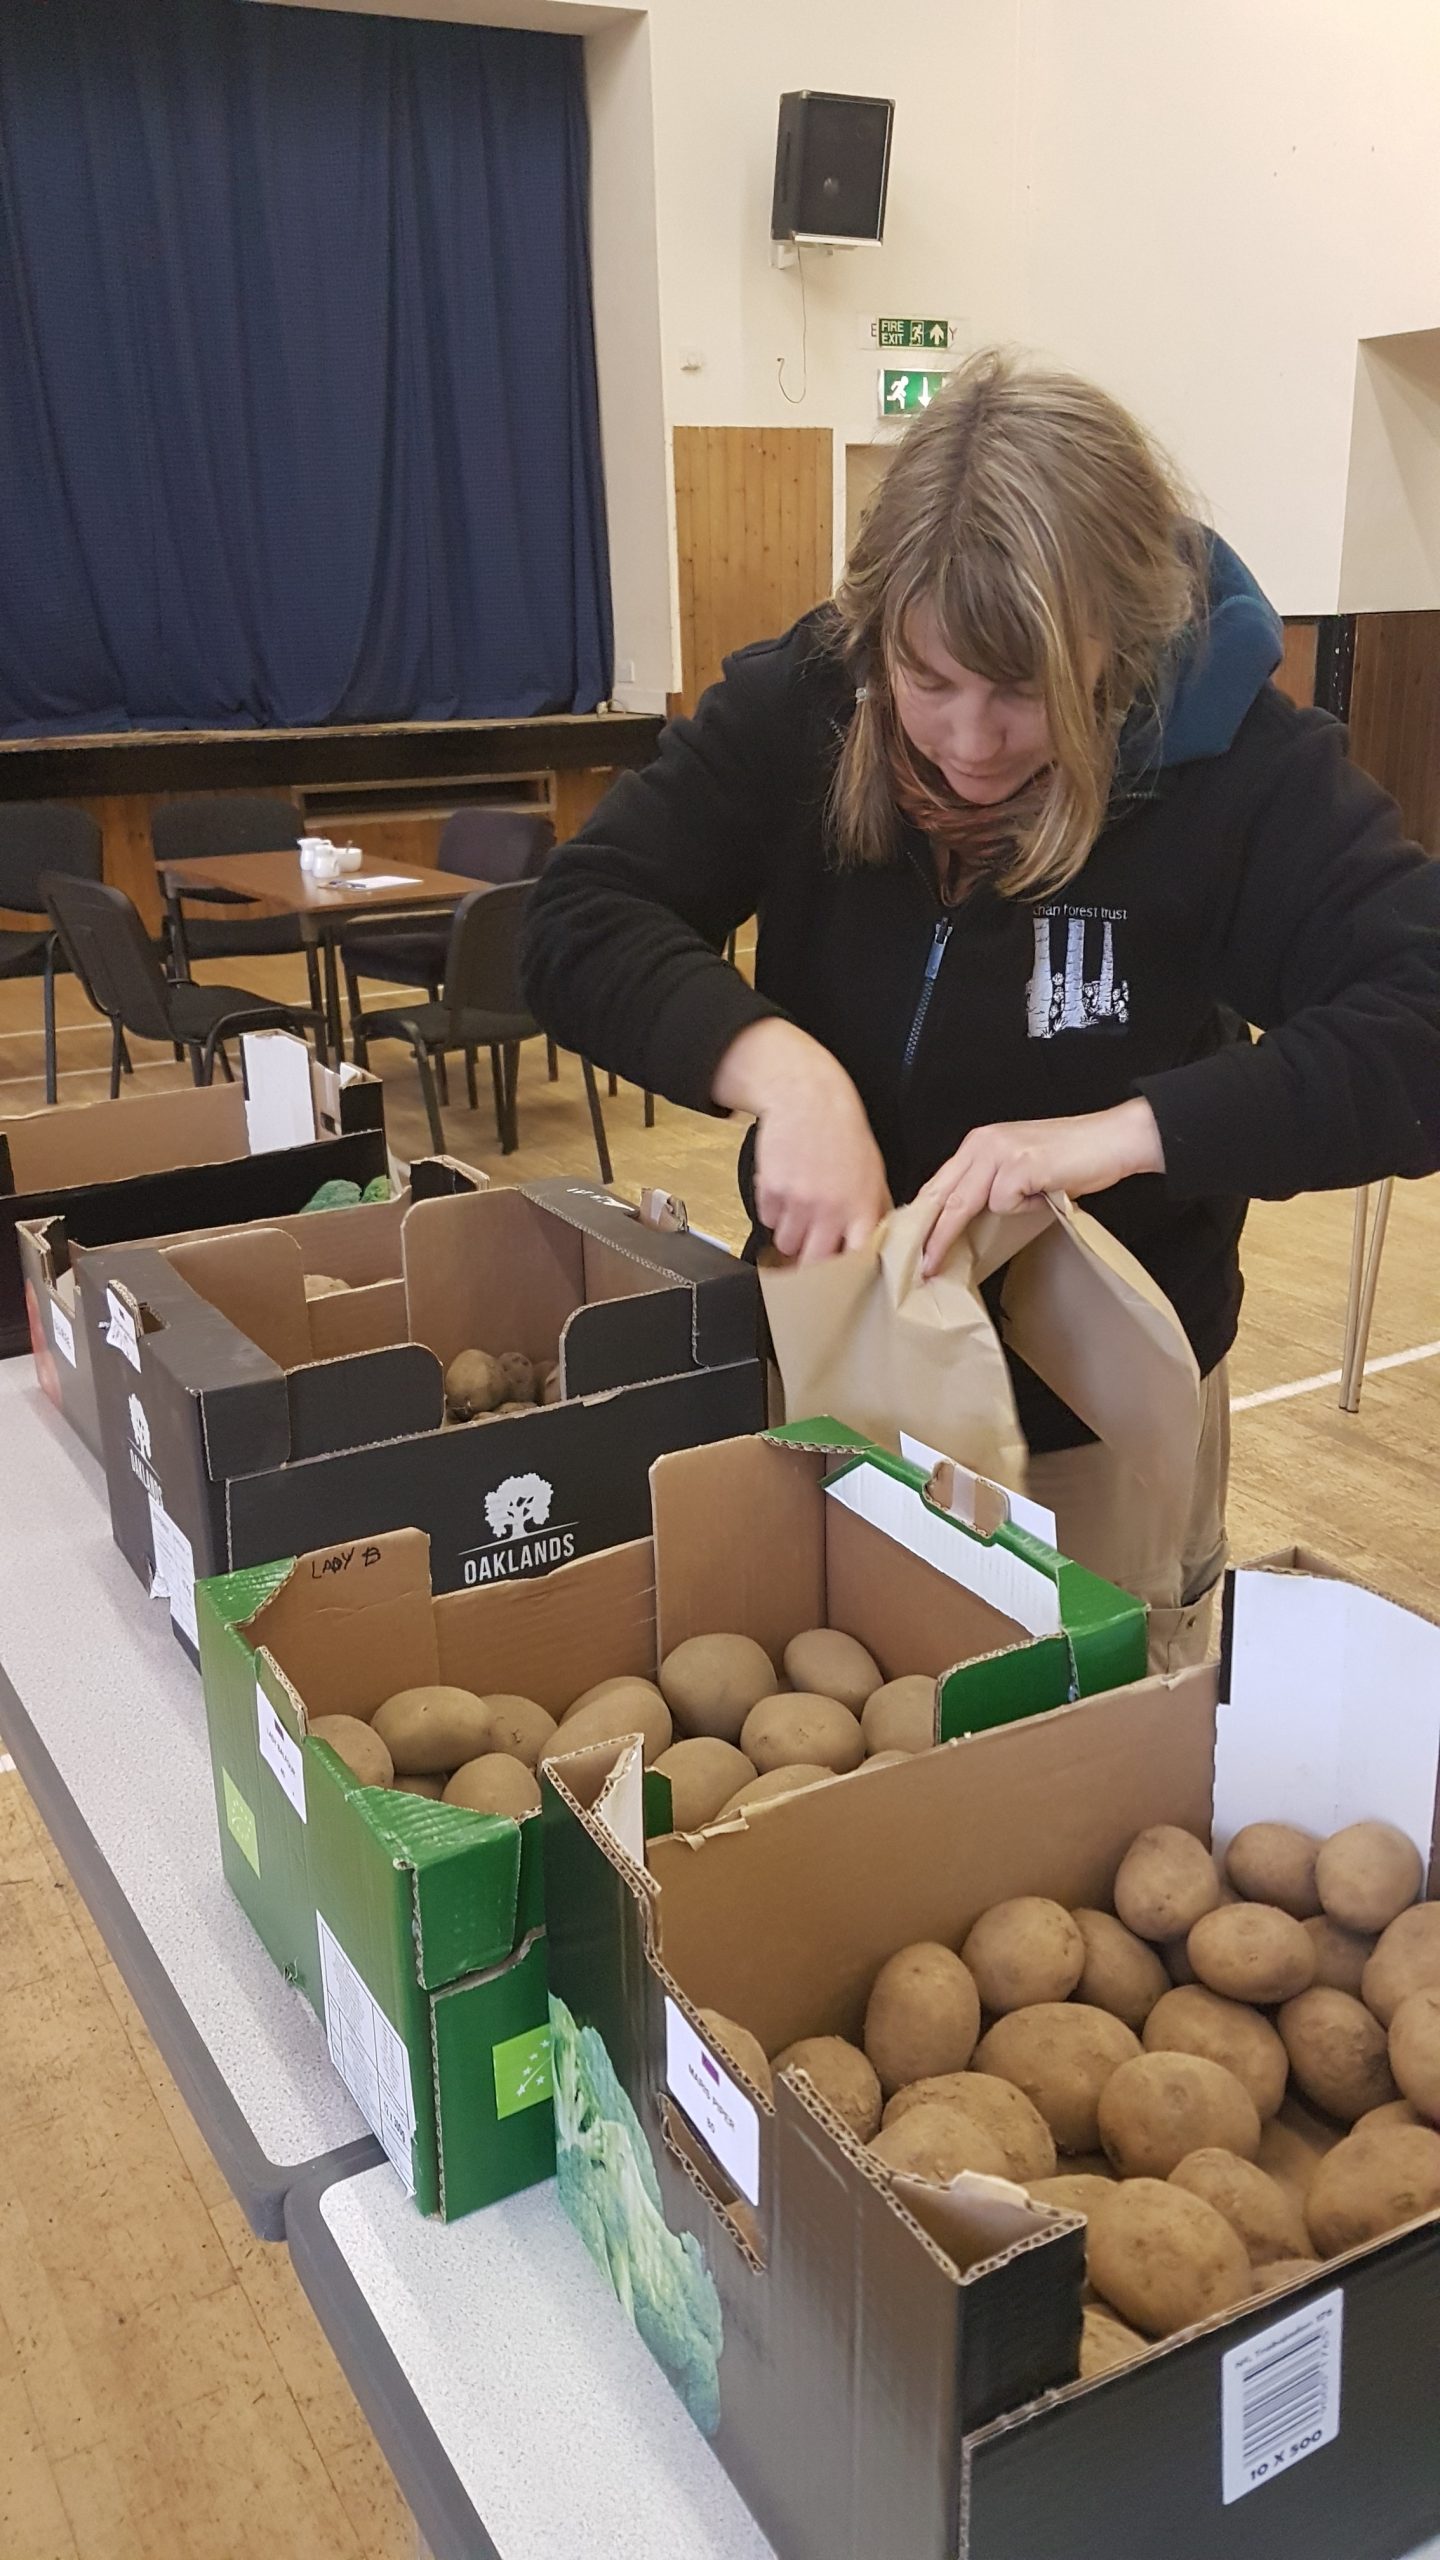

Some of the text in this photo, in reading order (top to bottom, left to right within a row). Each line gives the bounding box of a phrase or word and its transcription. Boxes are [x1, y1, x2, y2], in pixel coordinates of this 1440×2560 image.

[881, 320, 904, 332] FIRE
[881, 333, 904, 345] EXIT
[1063, 903, 1098, 918] forest
[1100, 907, 1128, 920] trust
[311, 1546, 381, 1579] LADY B
[464, 1533, 575, 1585] OAKLANDS
[688, 2063, 736, 2134] MARIS PIPER
[1250, 2463, 1269, 2480] 10
[1289, 2429, 1323, 2458] 500
